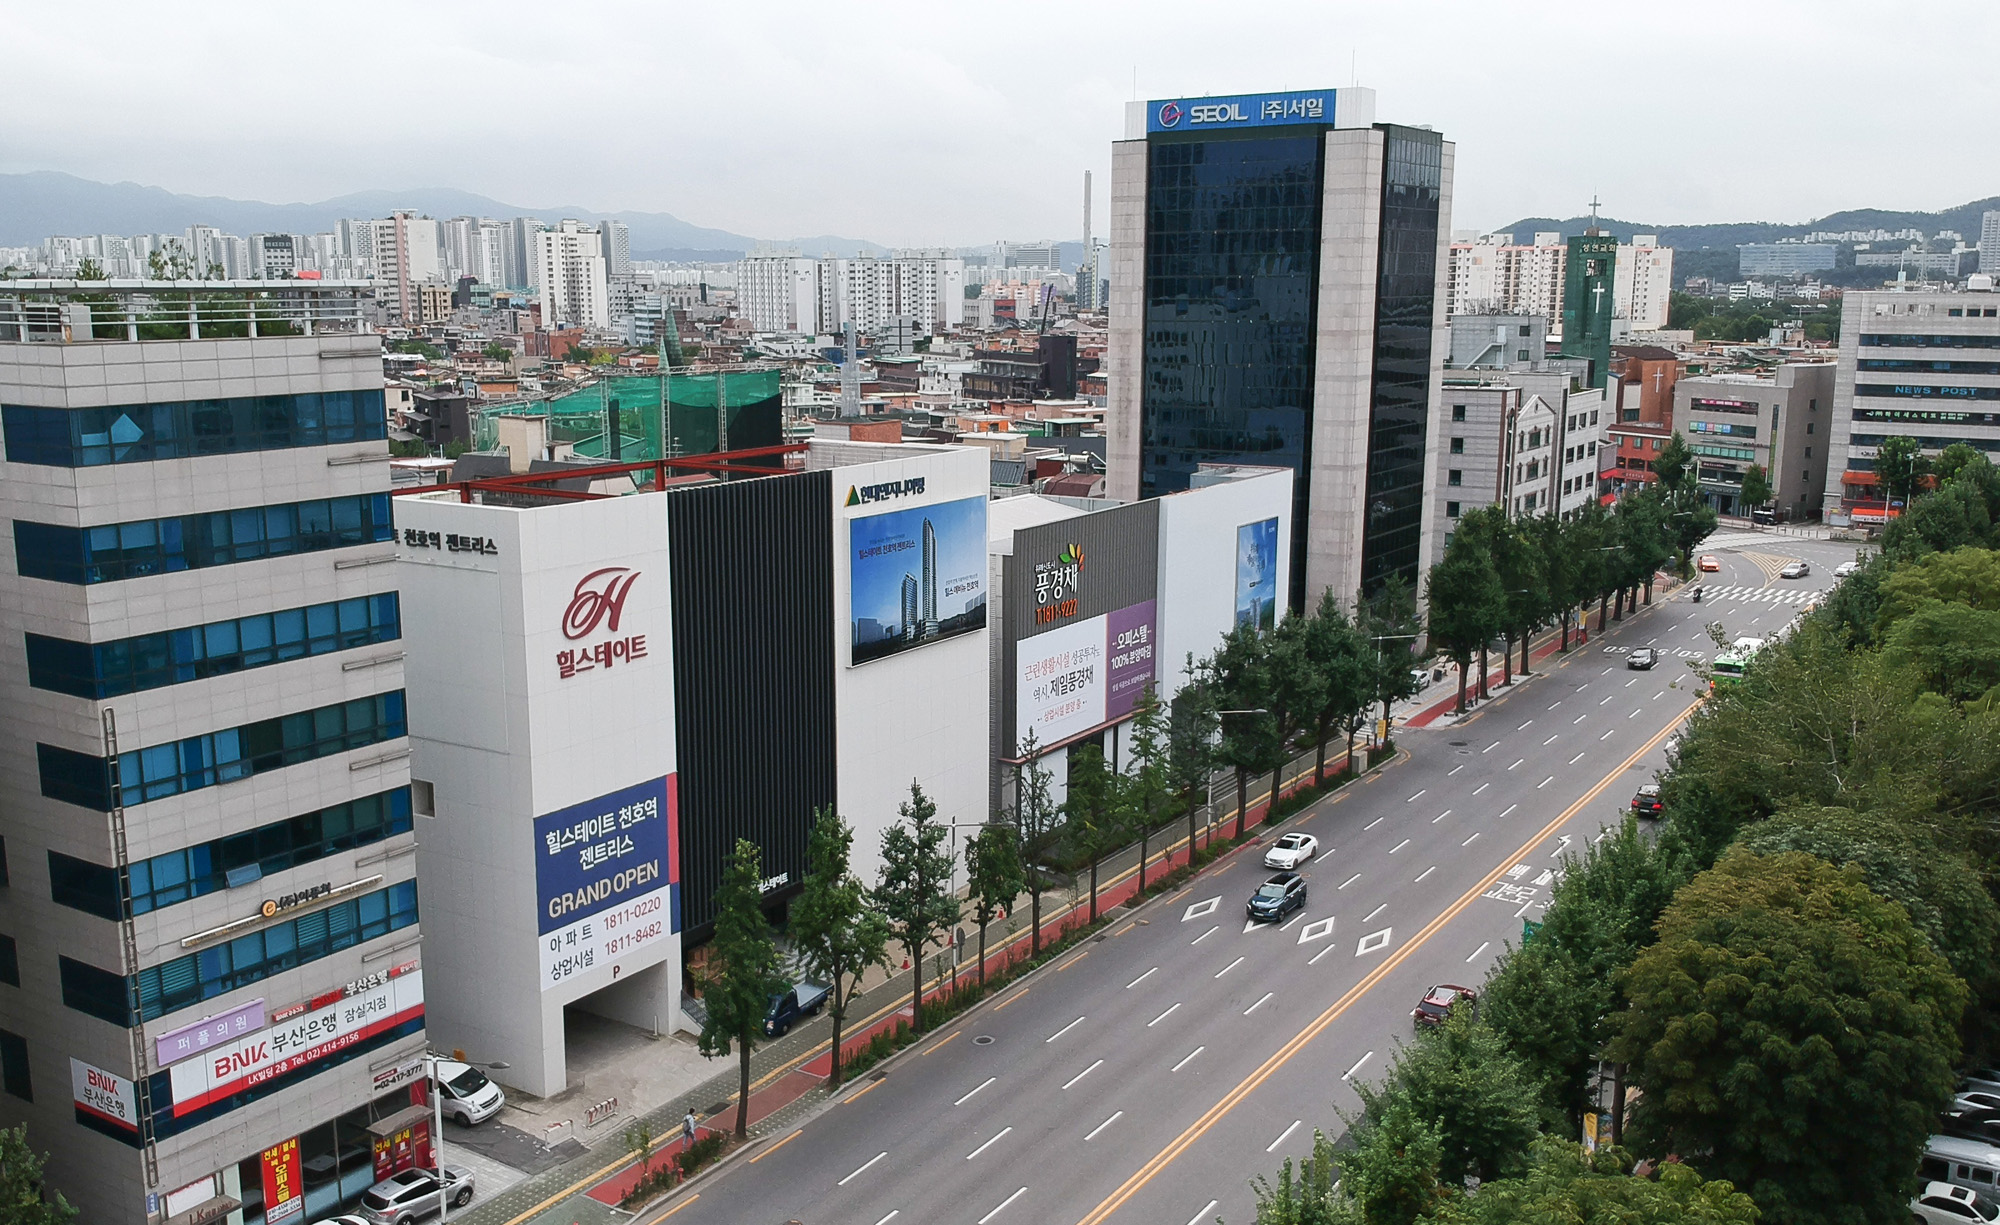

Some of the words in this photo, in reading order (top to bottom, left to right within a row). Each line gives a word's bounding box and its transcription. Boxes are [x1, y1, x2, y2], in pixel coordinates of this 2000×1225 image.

[1190, 104, 1248, 123] SEOIL
[1895, 386, 1931, 394] NEWS
[1941, 388, 1977, 396] POST
[860, 476, 925, 504] 현대엔지니어링
[404, 528, 441, 550] 천호역
[445, 534, 498, 555] 젠트리스
[1035, 564, 1078, 603] 풍경채
[1117, 624, 1148, 650] 오피스텔
[556, 635, 648, 679] 힐스테이트
[1024, 651, 1070, 681] 근린생활시설
[1111, 653, 1129, 670] 100%
[1129, 644, 1152, 664] 분양마감
[1050, 664, 1094, 696] 제일풍경채
[546, 813, 616, 855] 힐스테이트
[618, 797, 658, 829] 천호역
[580, 834, 634, 870] 젠트리스
[549, 878, 611, 918] GRAND
[613, 859, 659, 893] OPEN
[603, 896, 661, 930] 1811-0220
[551, 948, 594, 980] 상업시설
[605, 921, 662, 955] 1811-8482
[345, 969, 388, 996] 부산은행
[613, 965, 620, 979] P
[177, 1015, 247, 1049] 퍼플의원
[215, 1041, 269, 1078] BNK
[272, 1013, 337, 1053] 부산은행
[344, 995, 387, 1023] 잠실지점
[248, 1067, 274, 1085] LK빌딩
[275, 1062, 288, 1074] 2층
[292, 1055, 305, 1066] Tel.
[306, 1048, 320, 1060] 02)
[322, 1032, 359, 1054] 414-9156
[87, 1069, 119, 1096] BNK
[83, 1086, 125, 1118] 부산은행
[275, 1164, 290, 1203] 오피스텔
